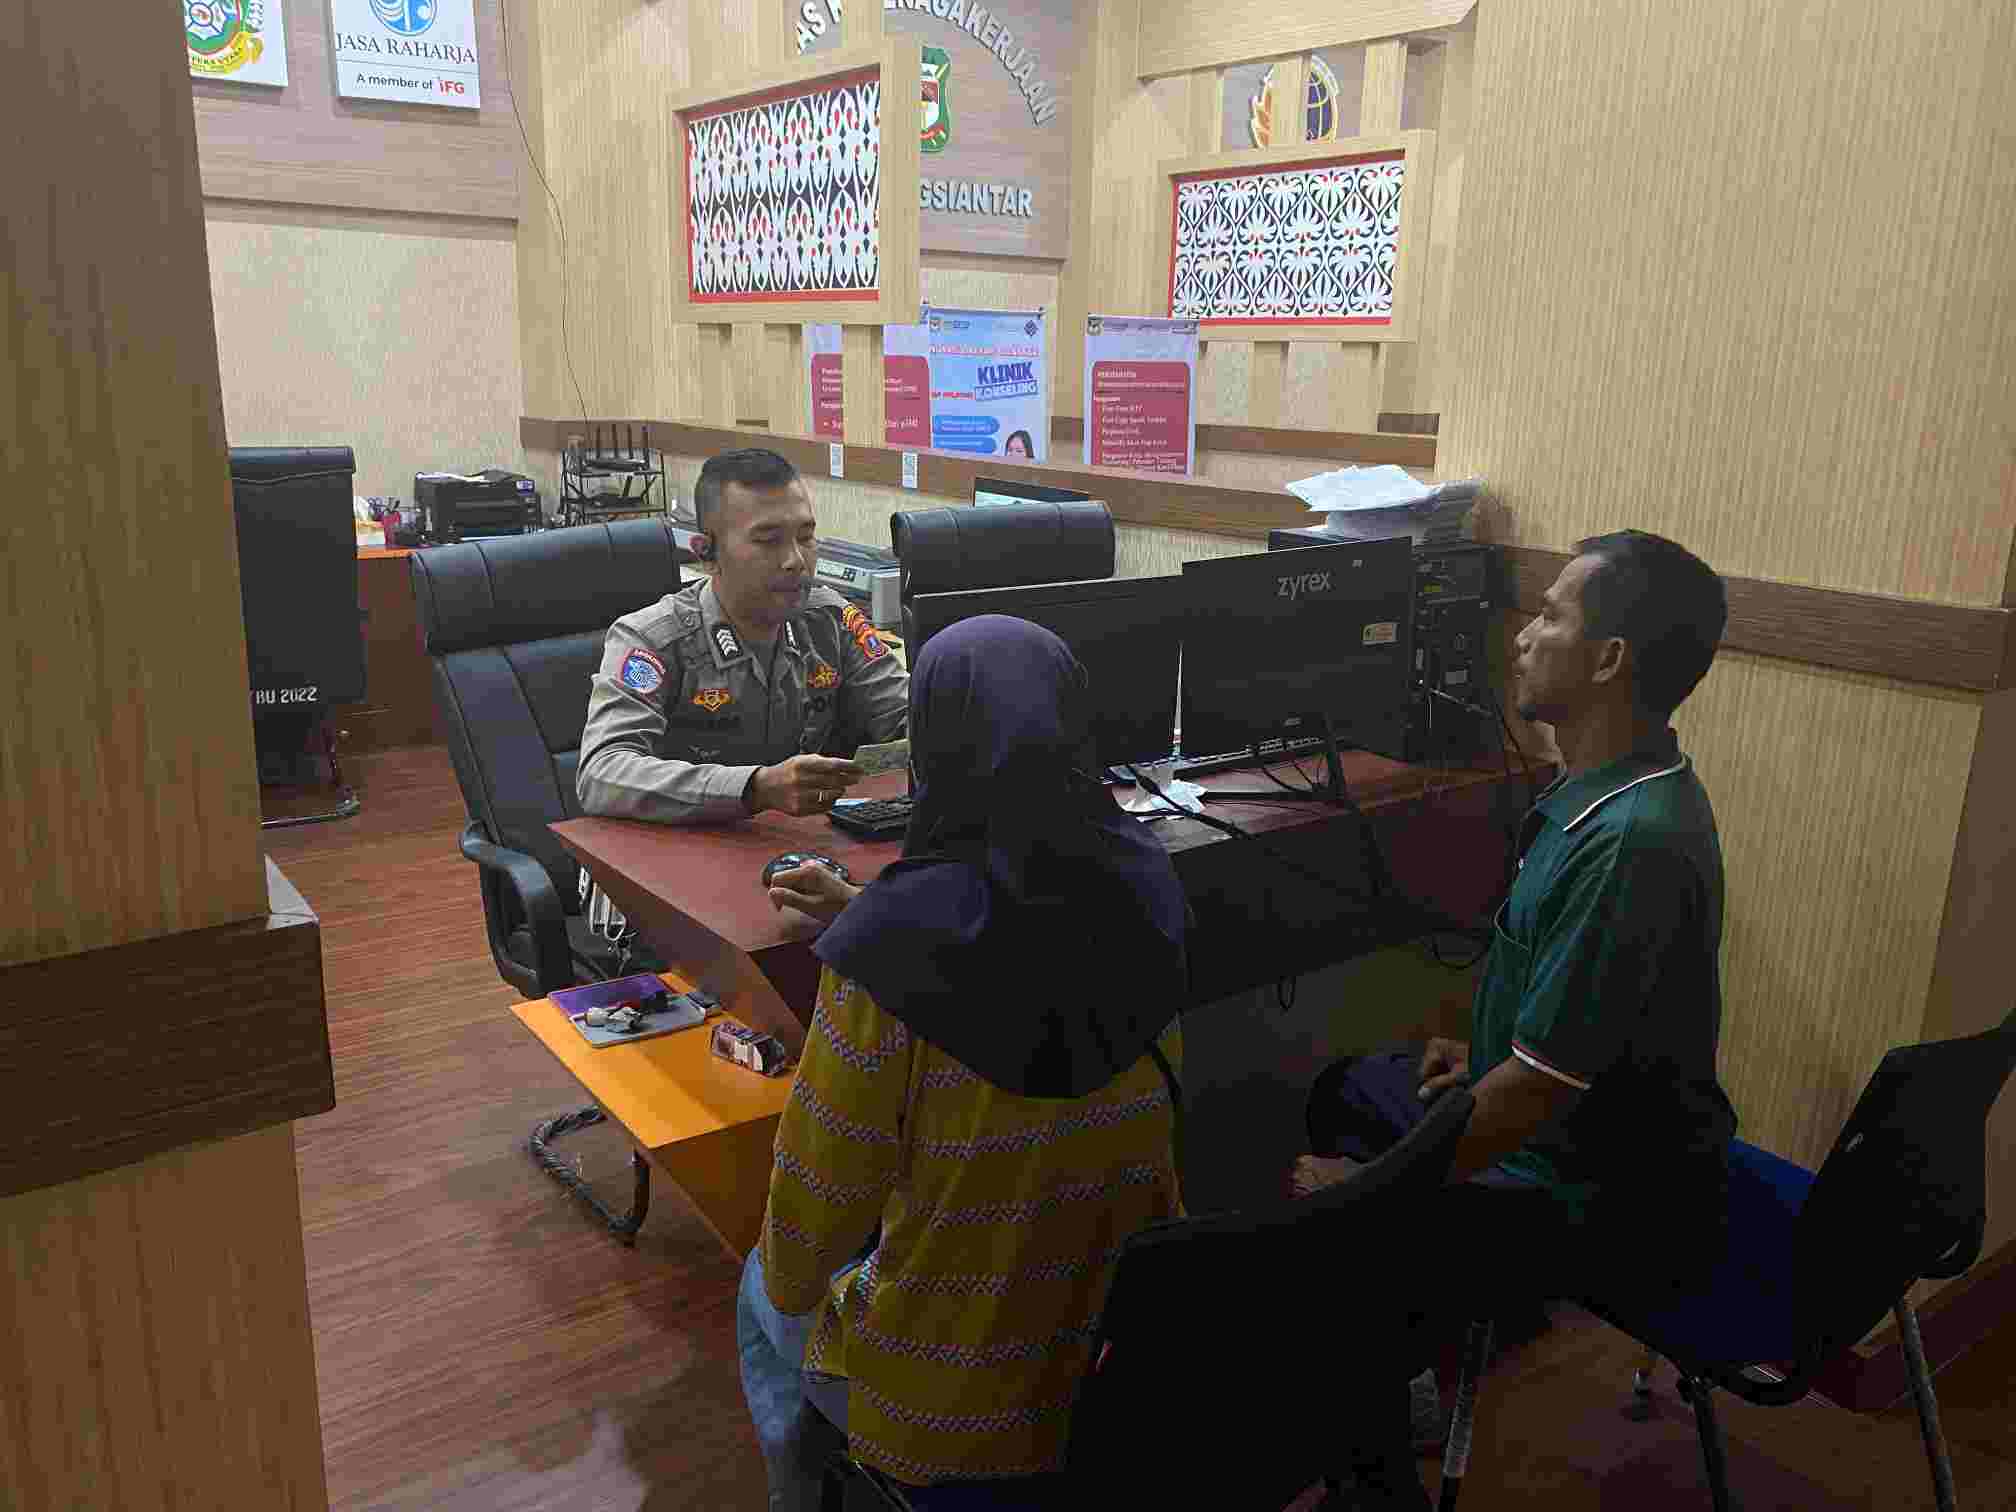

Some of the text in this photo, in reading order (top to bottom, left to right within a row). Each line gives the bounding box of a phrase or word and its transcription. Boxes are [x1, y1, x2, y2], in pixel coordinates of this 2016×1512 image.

[336, 33, 475, 64] JASA RAHARJA
[884, 0, 1056, 127] GAKERJAAN
[356, 73, 366, 84] A
[369, 75, 419, 88] member
[977, 361, 1032, 385] KLINIK
[1278, 571, 1330, 600] zyrex
